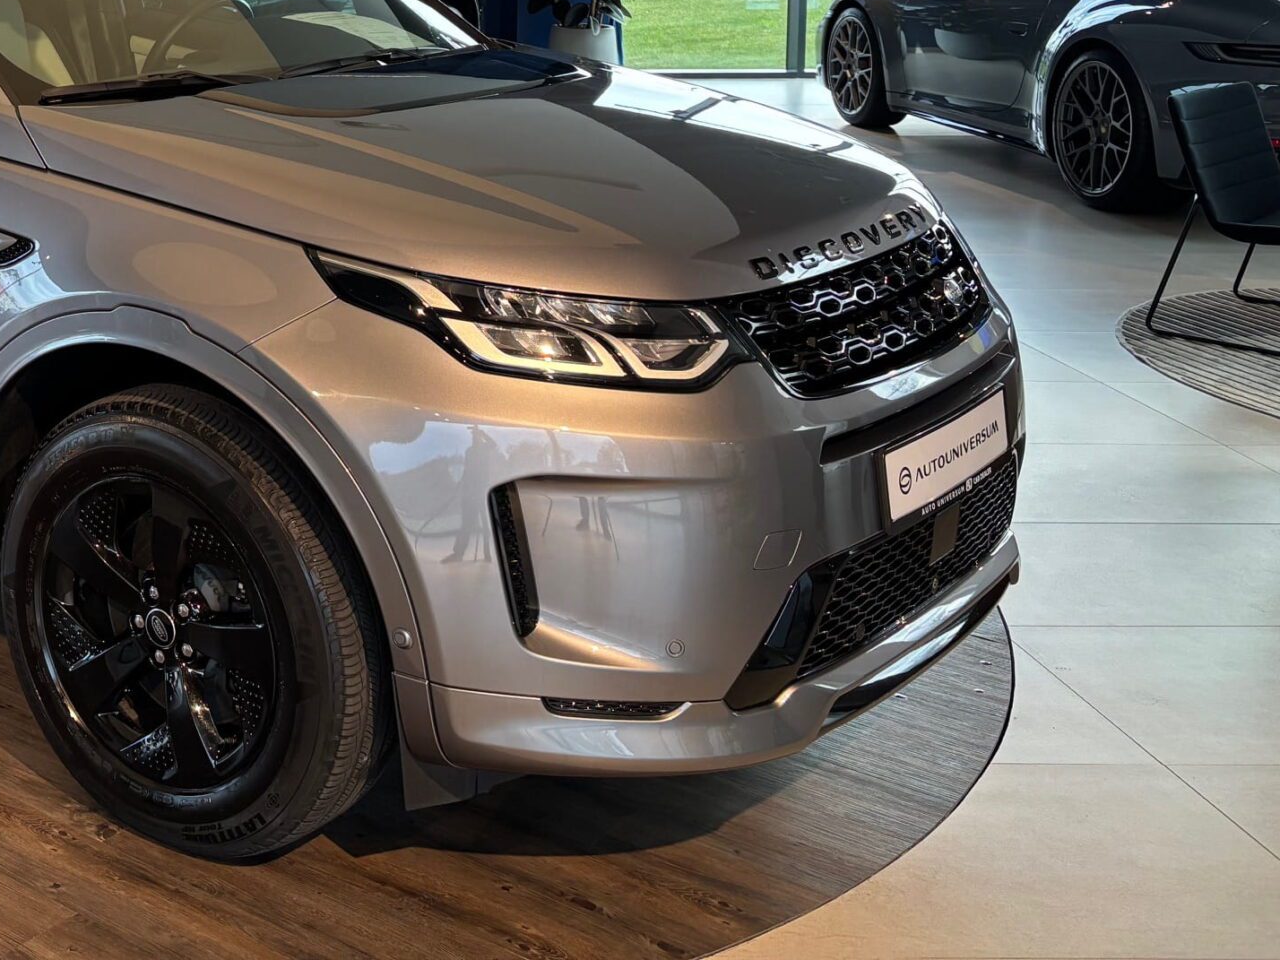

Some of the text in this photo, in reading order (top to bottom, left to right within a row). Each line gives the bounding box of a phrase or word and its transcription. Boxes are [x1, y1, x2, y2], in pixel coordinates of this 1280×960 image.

[748, 201, 927, 281] DISCOVERY
[915, 419, 1000, 483] AUTOUNIVERSUM
[921, 501, 936, 516] AUTO
[936, 485, 966, 508] UNIVERSUM
[181, 812, 267, 844] LATITUDE
